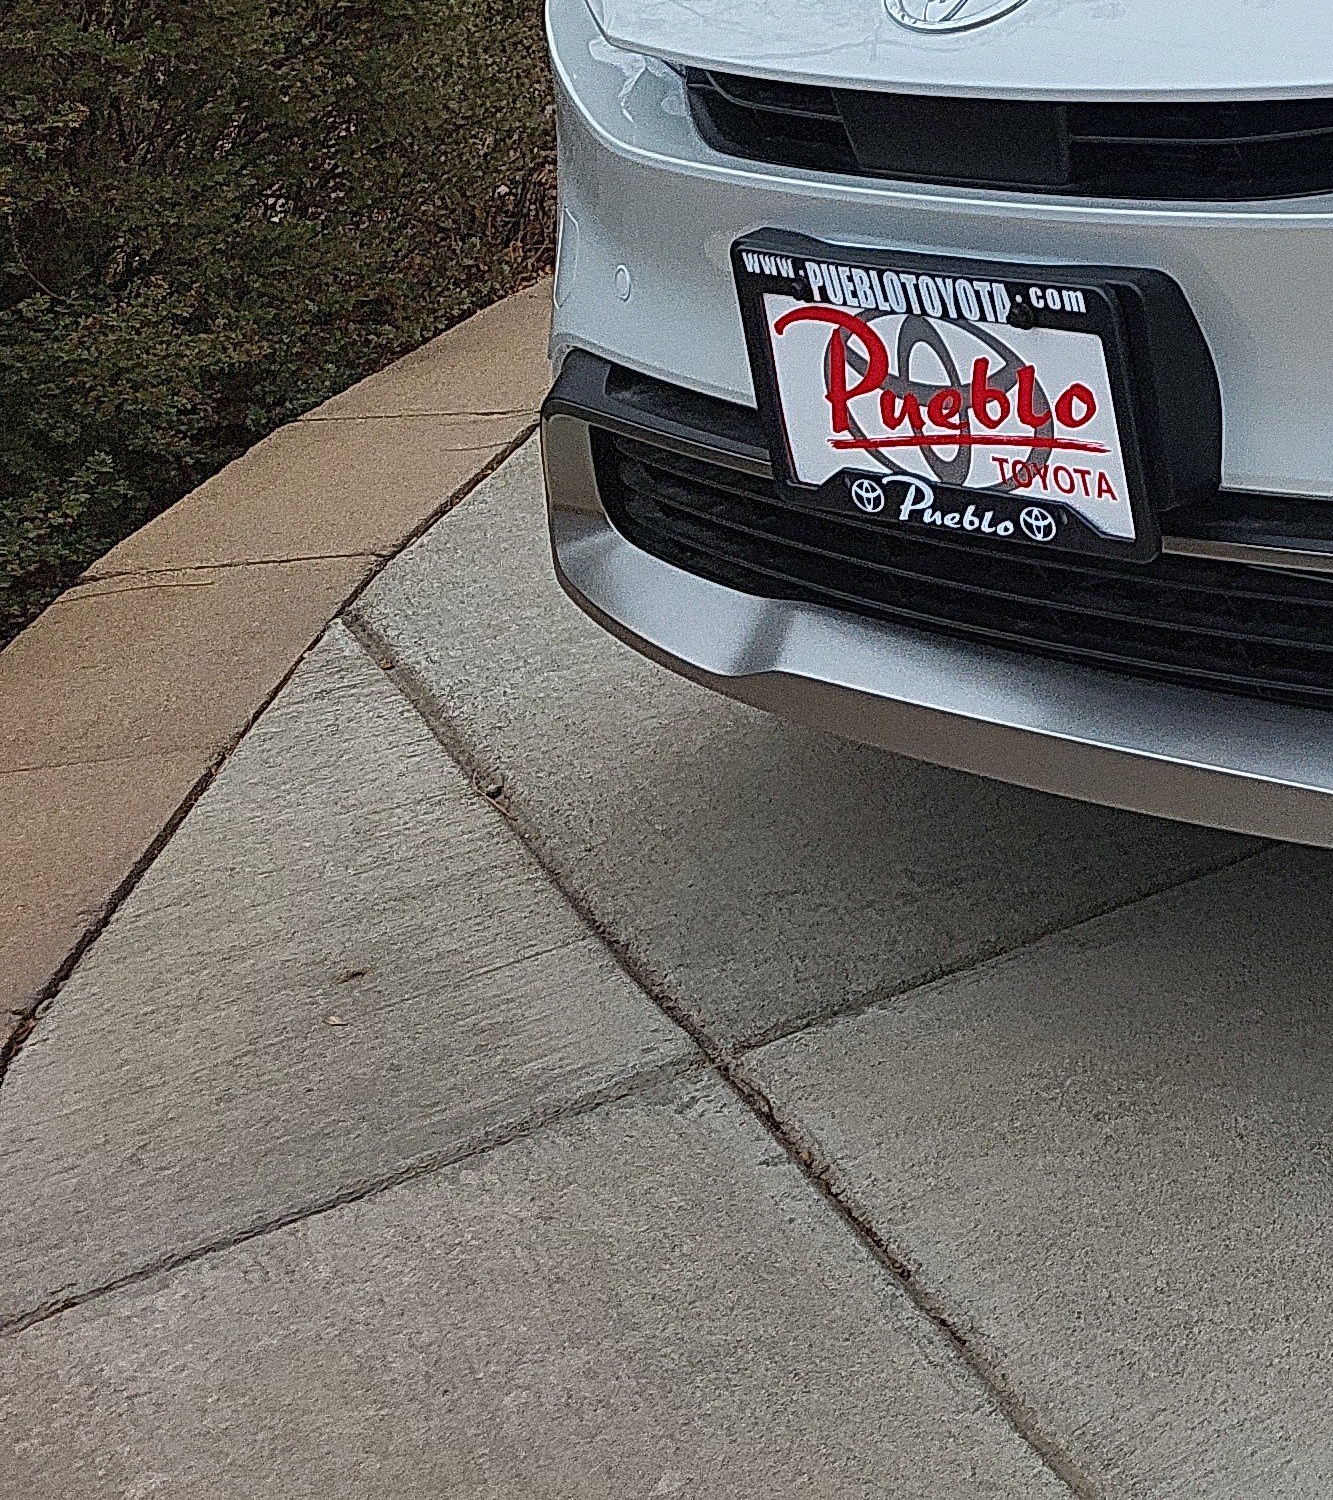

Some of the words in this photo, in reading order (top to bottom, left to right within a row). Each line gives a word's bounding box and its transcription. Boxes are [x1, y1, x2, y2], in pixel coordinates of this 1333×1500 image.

[774, 306, 1098, 433] Pueblo
[882, 475, 1015, 537] Pueblo
[992, 455, 1118, 501] TOYOTA
